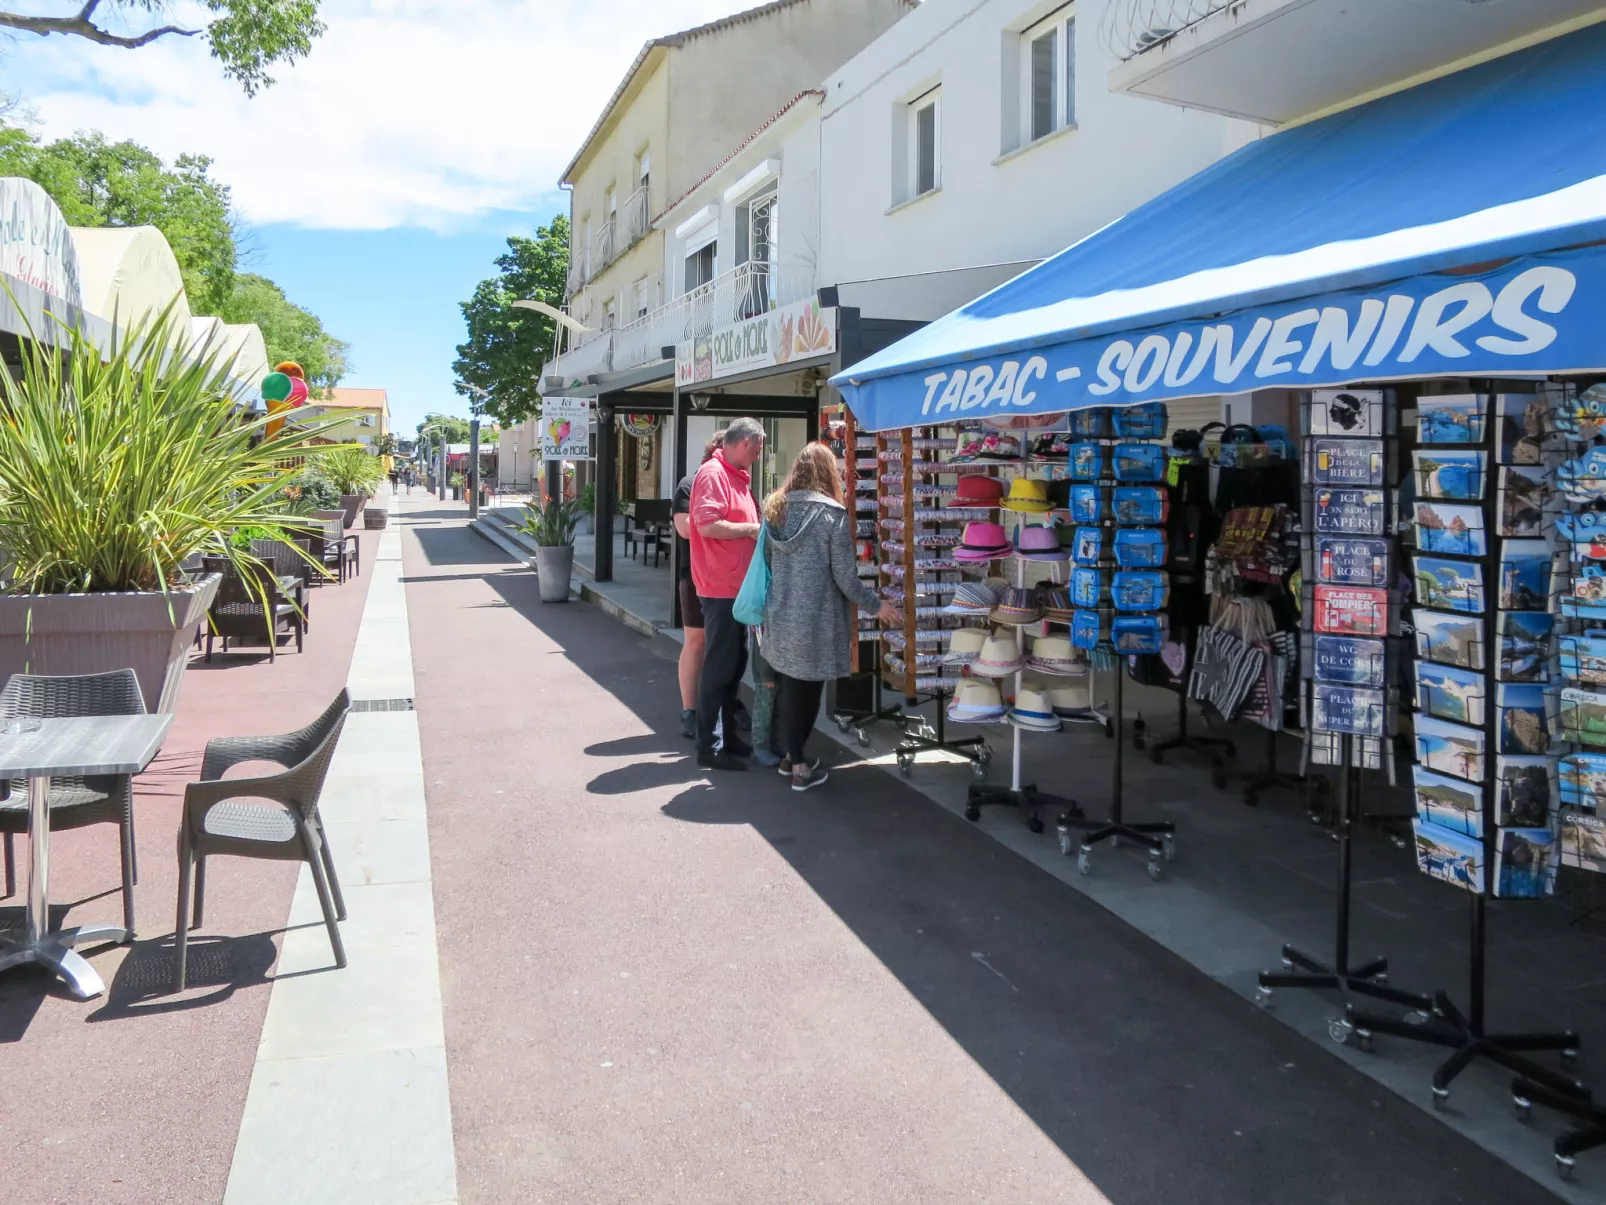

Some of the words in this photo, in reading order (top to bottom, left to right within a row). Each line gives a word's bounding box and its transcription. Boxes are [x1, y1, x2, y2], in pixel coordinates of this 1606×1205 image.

[921, 355, 1048, 416] TABAC
[1087, 265, 1577, 396] SOUVENIRS
[1329, 447, 1368, 457] PLACE
[1330, 466, 1367, 478] BIÈRE
[1340, 493, 1357, 503] ICI
[1344, 507, 1369, 515] SERT
[1335, 546, 1371, 556] PLACE
[1344, 558, 1358, 566] DU
[1328, 591, 1355, 600] PLACE
[1356, 592, 1373, 600] DES
[1325, 598, 1377, 611] POMPIERS
[1321, 655, 1337, 665] DE
[1566, 814, 1606, 828] CORSICA
